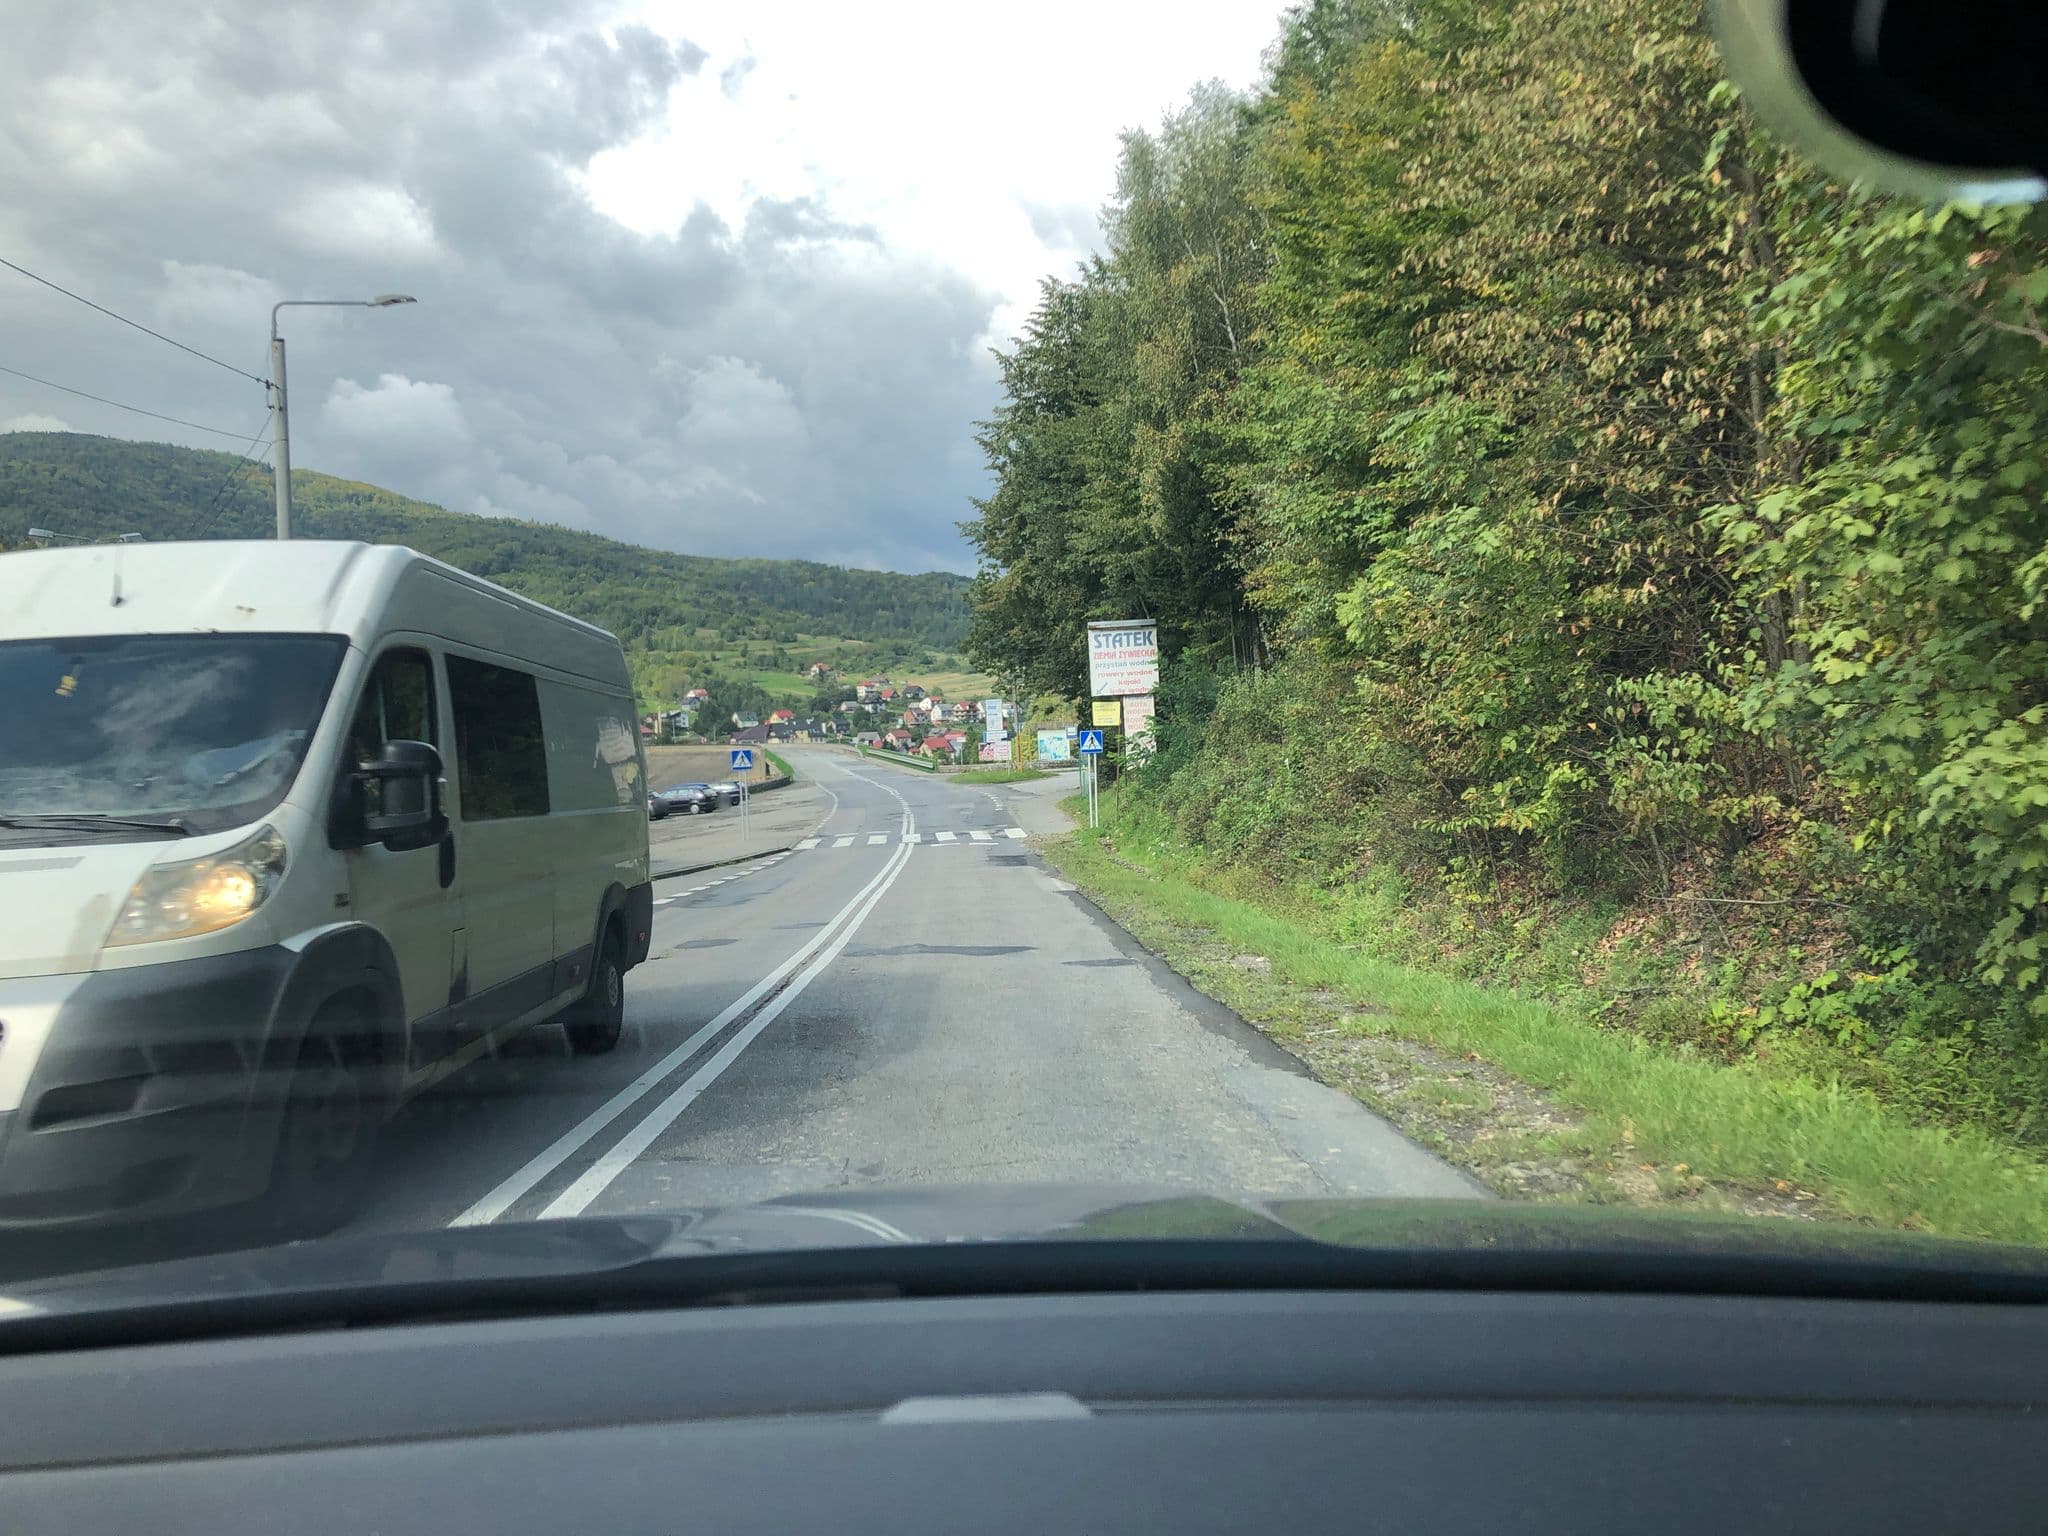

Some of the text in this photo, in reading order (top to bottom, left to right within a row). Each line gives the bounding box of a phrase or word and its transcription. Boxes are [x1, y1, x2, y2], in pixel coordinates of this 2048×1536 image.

[1093, 631, 1154, 649] STATEK
[1094, 651, 1117, 660] ZIEMIA
[1098, 671, 1124, 679] rowery
